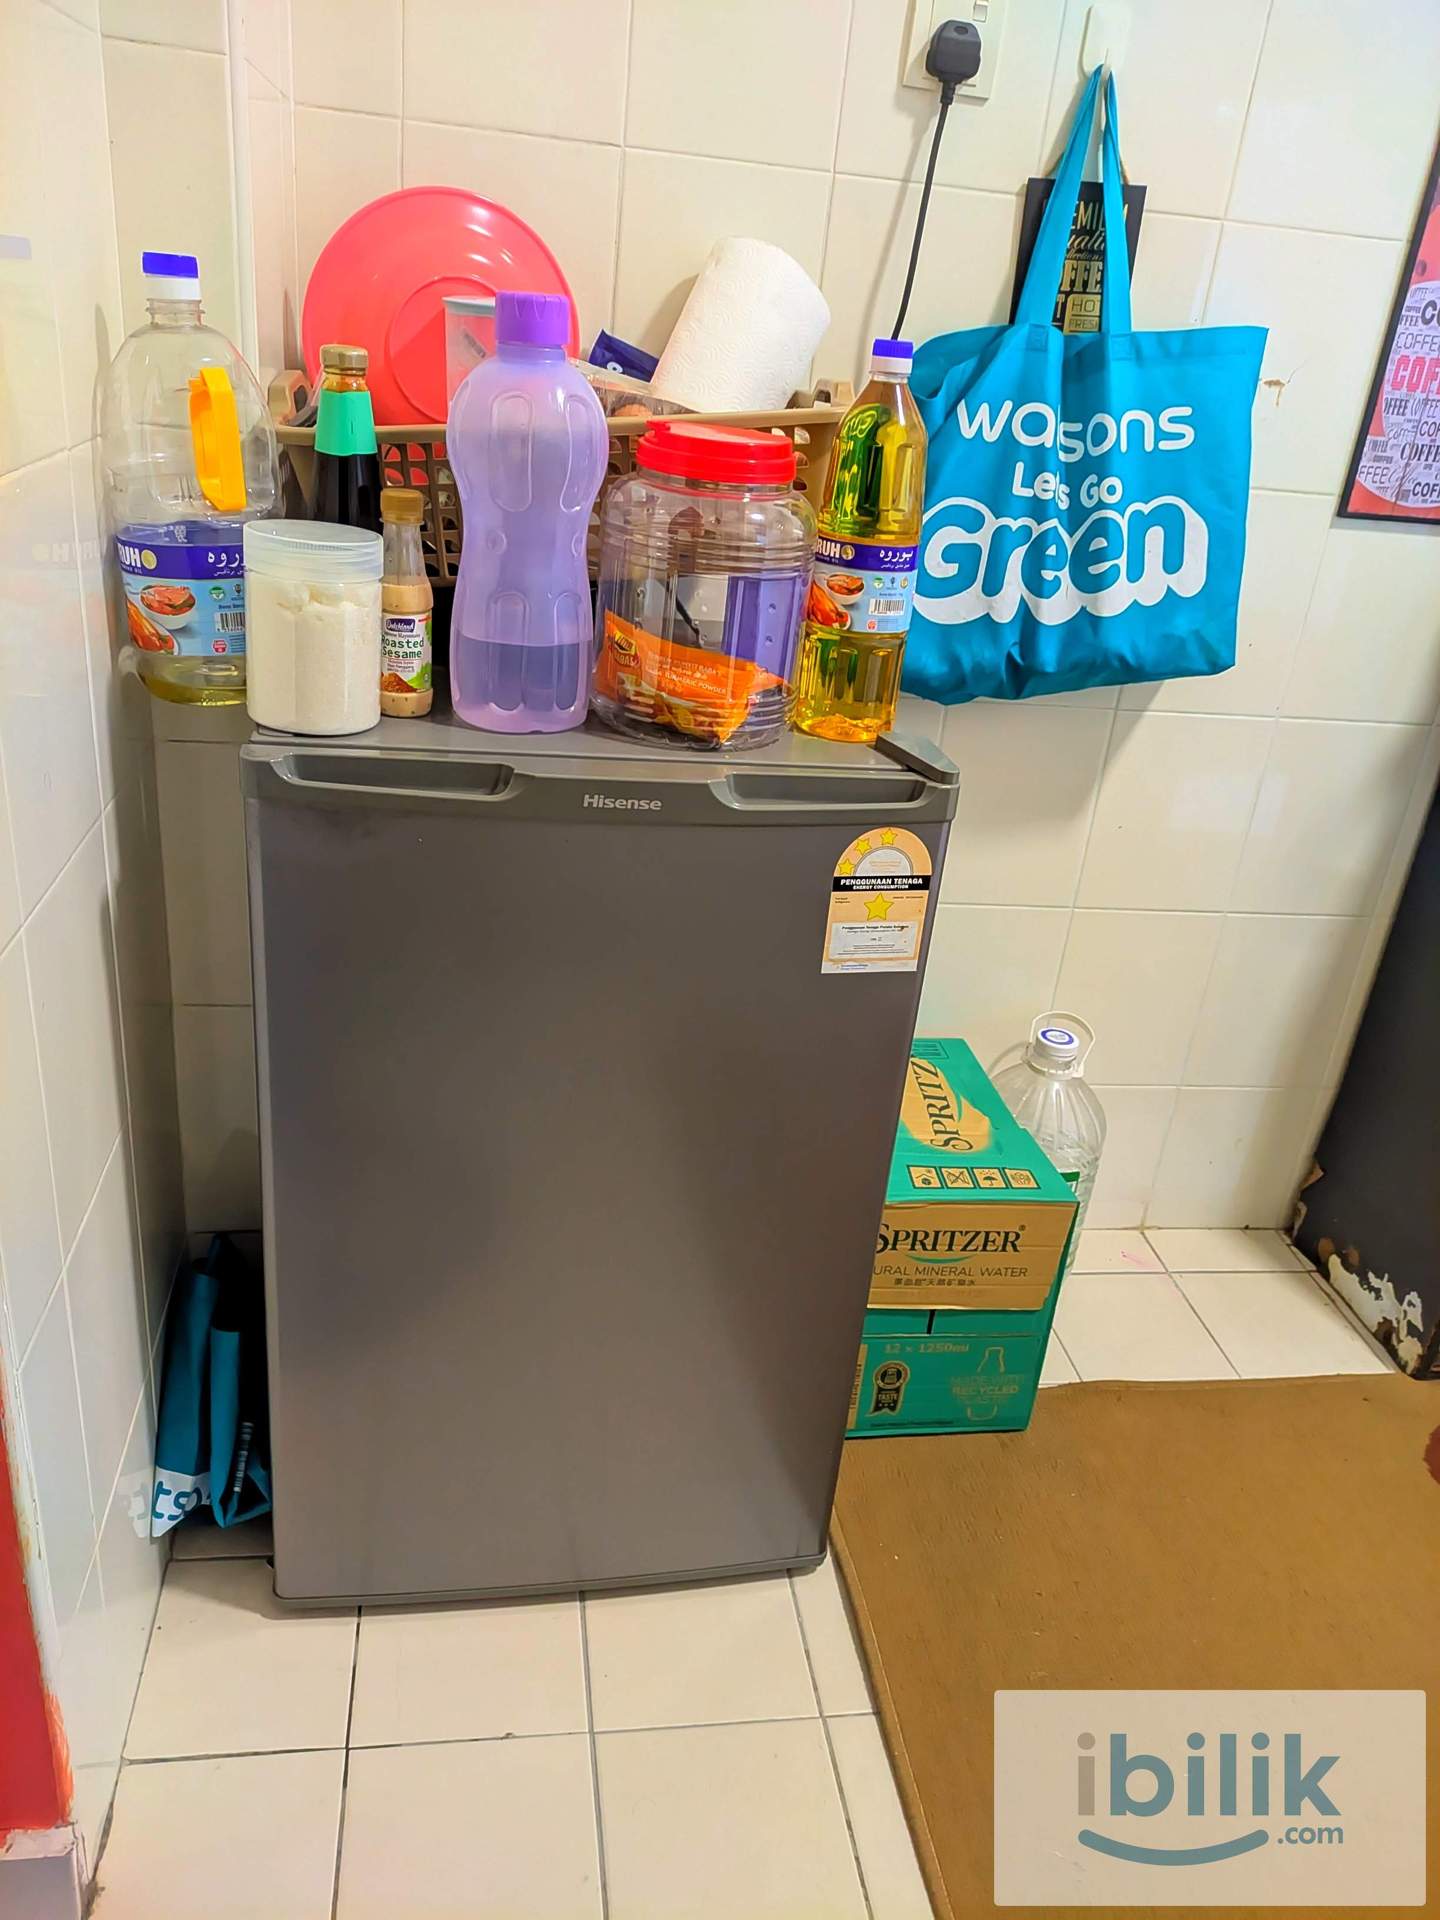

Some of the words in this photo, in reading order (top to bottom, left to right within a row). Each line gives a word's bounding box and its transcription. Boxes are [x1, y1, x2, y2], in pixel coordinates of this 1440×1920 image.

[1396, 332, 1440, 352] COFFE
[1080, 474, 1123, 508] Go
[914, 496, 1209, 625] Green
[382, 646, 422, 659] Sesame
[583, 794, 662, 810] Hisense
[840, 878, 892, 886] PENGGUNAAN
[911, 1060, 973, 1151] SPRITZ
[874, 1265, 910, 1276] URAL
[914, 1265, 974, 1277] MINERAL
[980, 1267, 1028, 1278] WATER
